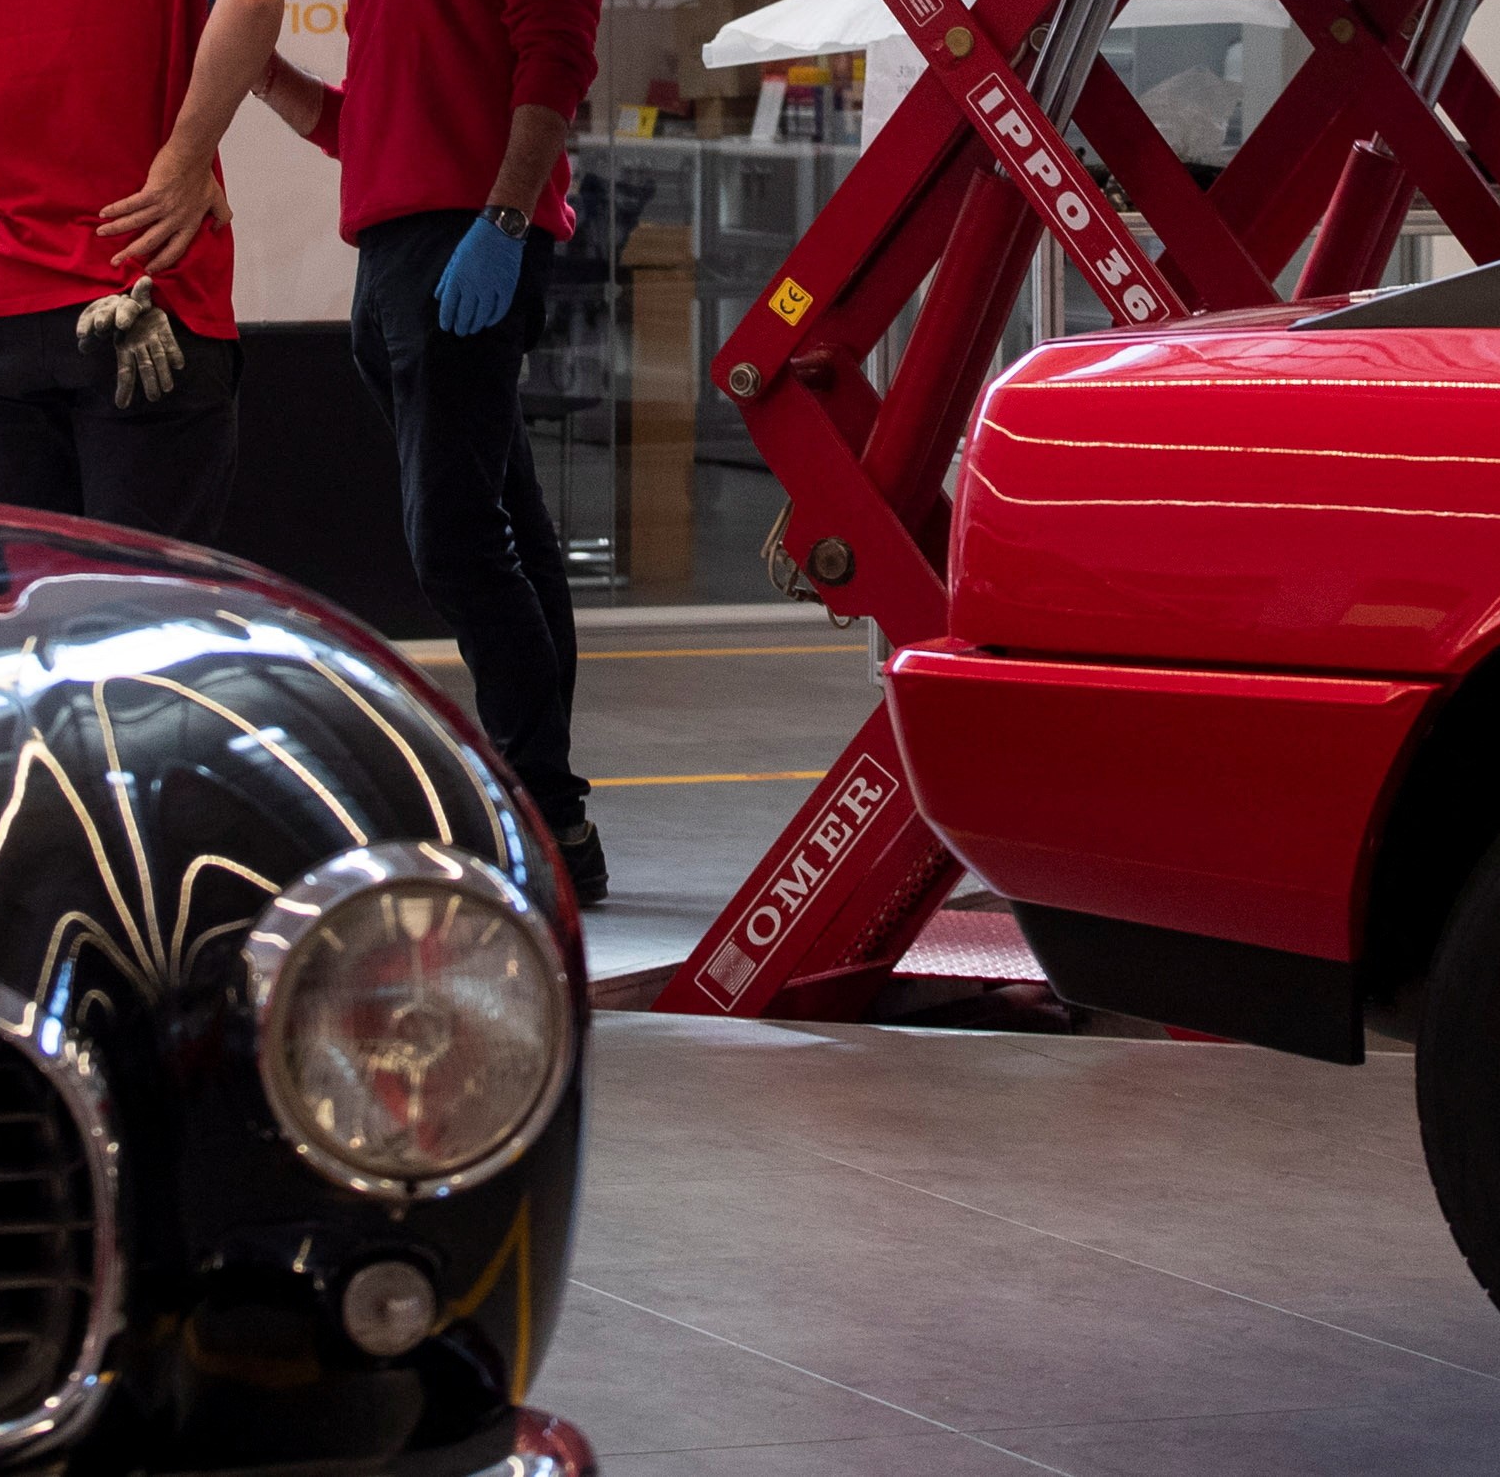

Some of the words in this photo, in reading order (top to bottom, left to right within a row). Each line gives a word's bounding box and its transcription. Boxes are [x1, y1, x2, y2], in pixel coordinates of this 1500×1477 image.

[977, 86, 1090, 231] IPPO
[1096, 248, 1157, 321] 36
[746, 777, 883, 947] OMER
